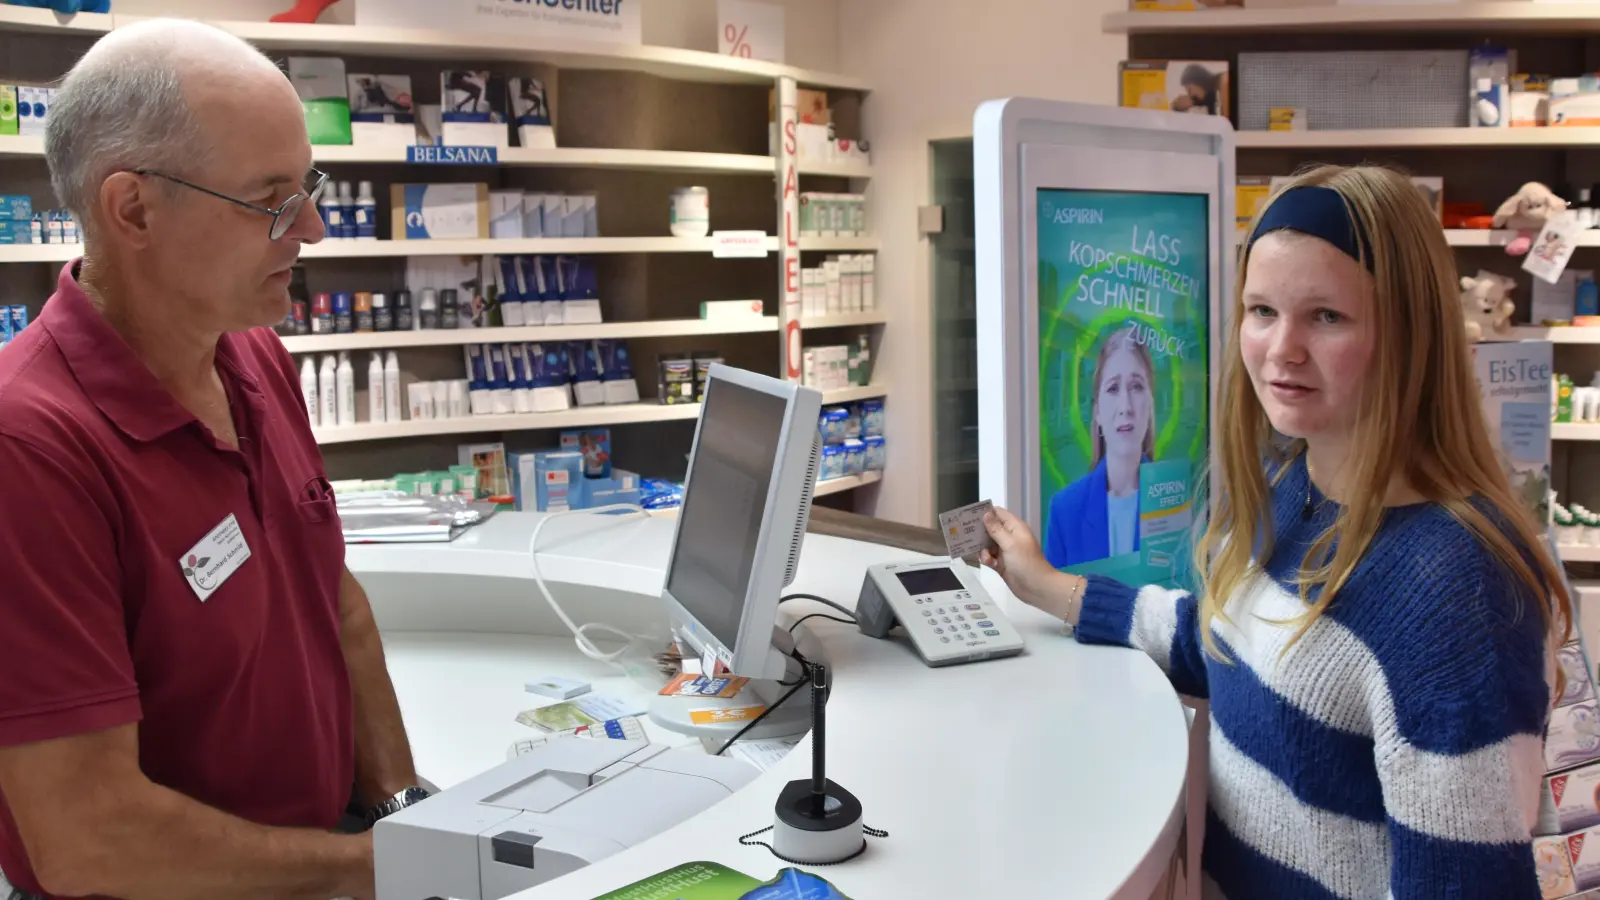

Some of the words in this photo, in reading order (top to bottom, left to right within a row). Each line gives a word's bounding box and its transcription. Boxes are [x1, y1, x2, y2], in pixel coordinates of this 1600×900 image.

[414, 147, 492, 163] BELSANA
[784, 119, 798, 293] SALE
[1053, 208, 1104, 224] ASPIRIN
[1131, 224, 1181, 267] LASS
[1069, 240, 1200, 299] KOPSCHMERZEN
[1076, 274, 1165, 318] SCHNELL
[1126, 320, 1185, 359] ZURÜCK
[1489, 359, 1549, 384] EisTee
[1147, 480, 1186, 498] ASPIRIN
[199, 575, 208, 585] Dr.
[207, 556, 227, 578] Bernhard
